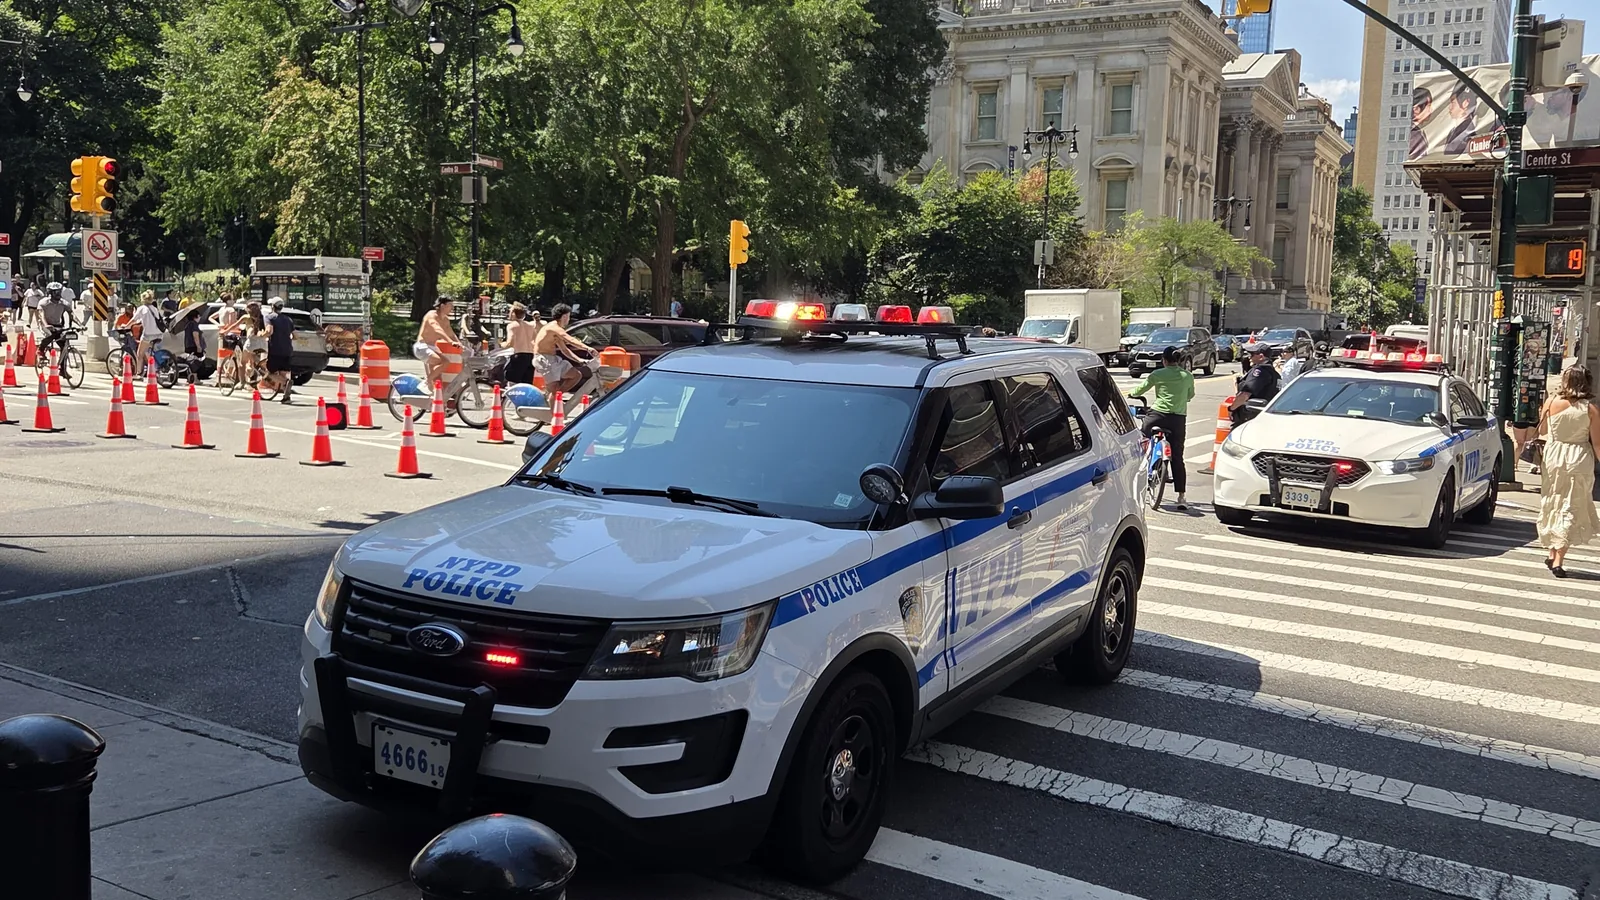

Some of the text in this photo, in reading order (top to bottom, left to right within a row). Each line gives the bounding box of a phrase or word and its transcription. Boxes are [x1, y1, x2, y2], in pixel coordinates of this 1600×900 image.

[1470, 139, 1493, 152] Chamber
[1526, 152, 1571, 166] Centre St
[1284, 442, 1341, 454] POLICE
[1297, 438, 1335, 446] NYPD
[1284, 491, 1309, 503] 3339
[436, 556, 522, 578] NYPD
[402, 568, 524, 606] POLICE
[801, 568, 864, 614] POLICE
[937, 539, 1023, 641] NYPD
[416, 629, 448, 650] Ford
[381, 741, 445, 778] 4666 18
